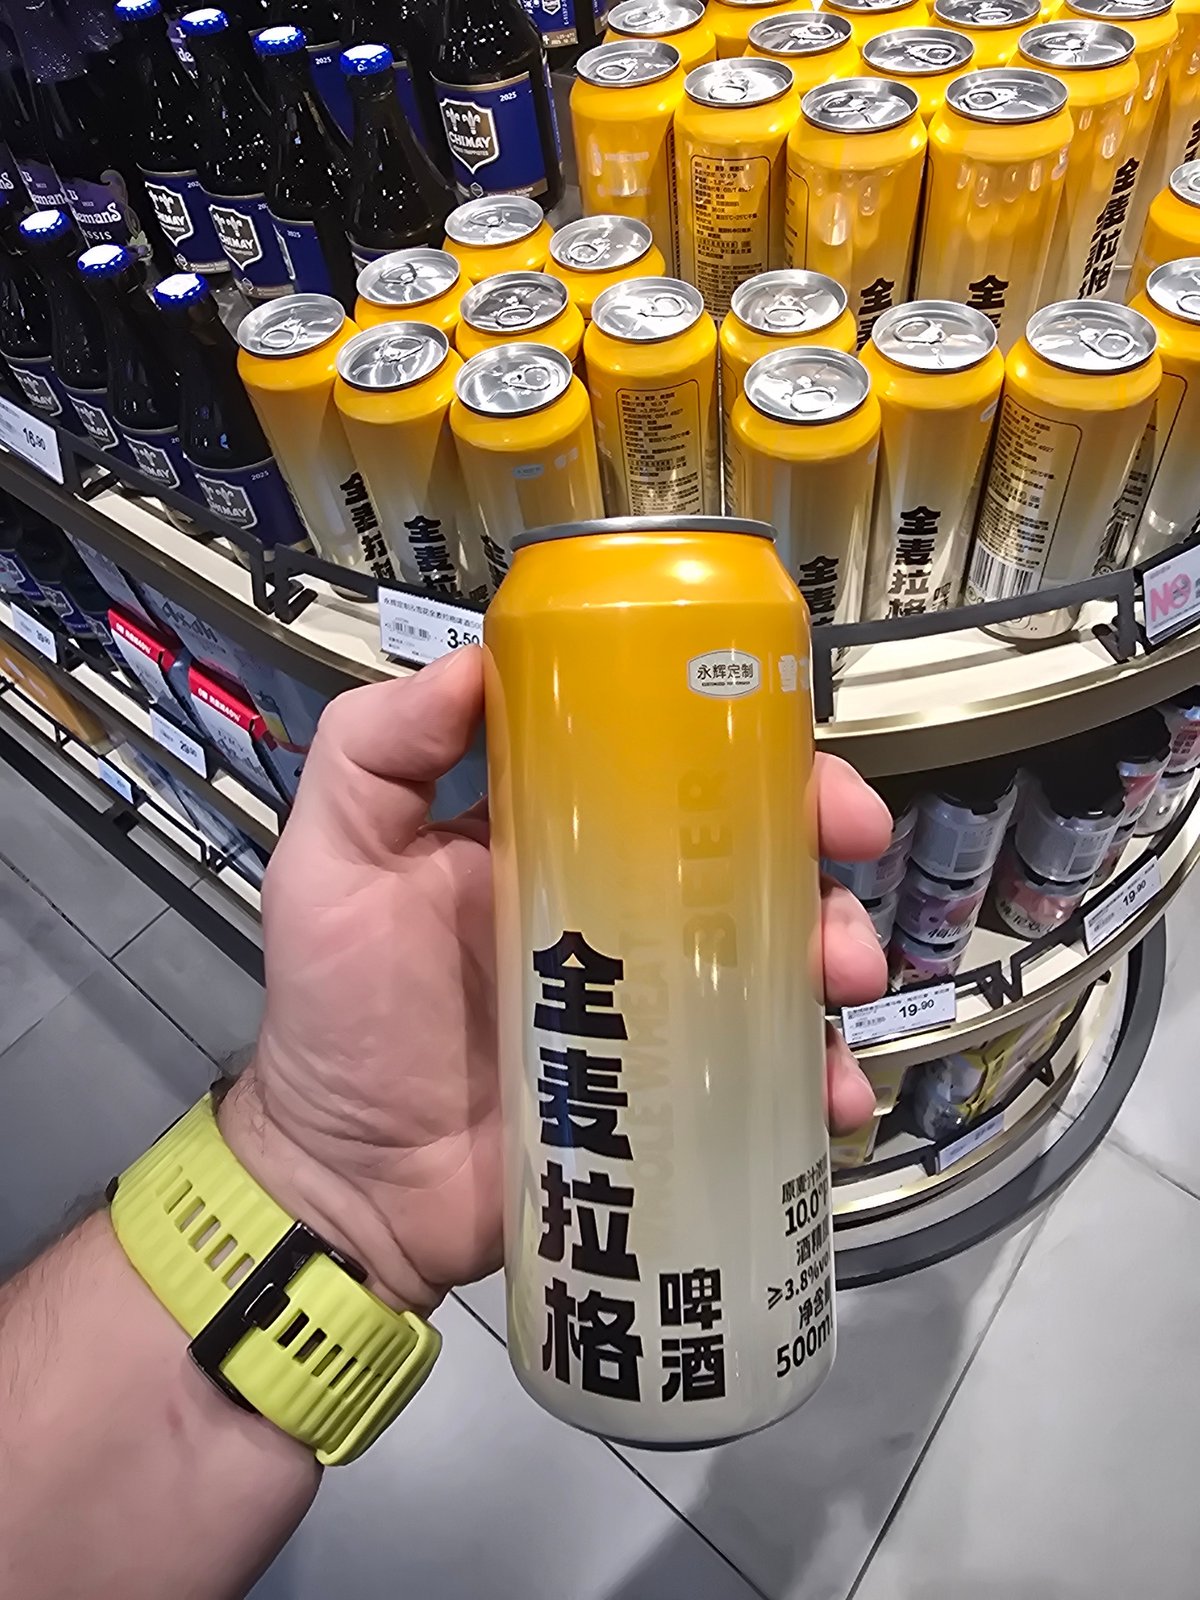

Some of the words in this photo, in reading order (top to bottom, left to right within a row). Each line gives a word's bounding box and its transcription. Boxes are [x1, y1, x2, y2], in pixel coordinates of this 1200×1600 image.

[500, 91, 517, 102] 2025
[449, 132, 491, 149] CHIMAY
[219, 231, 255, 250] CHIMAY
[251, 470, 269, 481] 2025
[797, 555, 839, 626] 全麦
[447, 627, 480, 649] 3.50
[697, 663, 754, 680] 永辉定制
[1122, 879, 1147, 906] 19.90
[899, 998, 935, 1019] 19.90
[532, 930, 644, 1402] 全麦拉格
[659, 1266, 726, 1403] 啤酒
